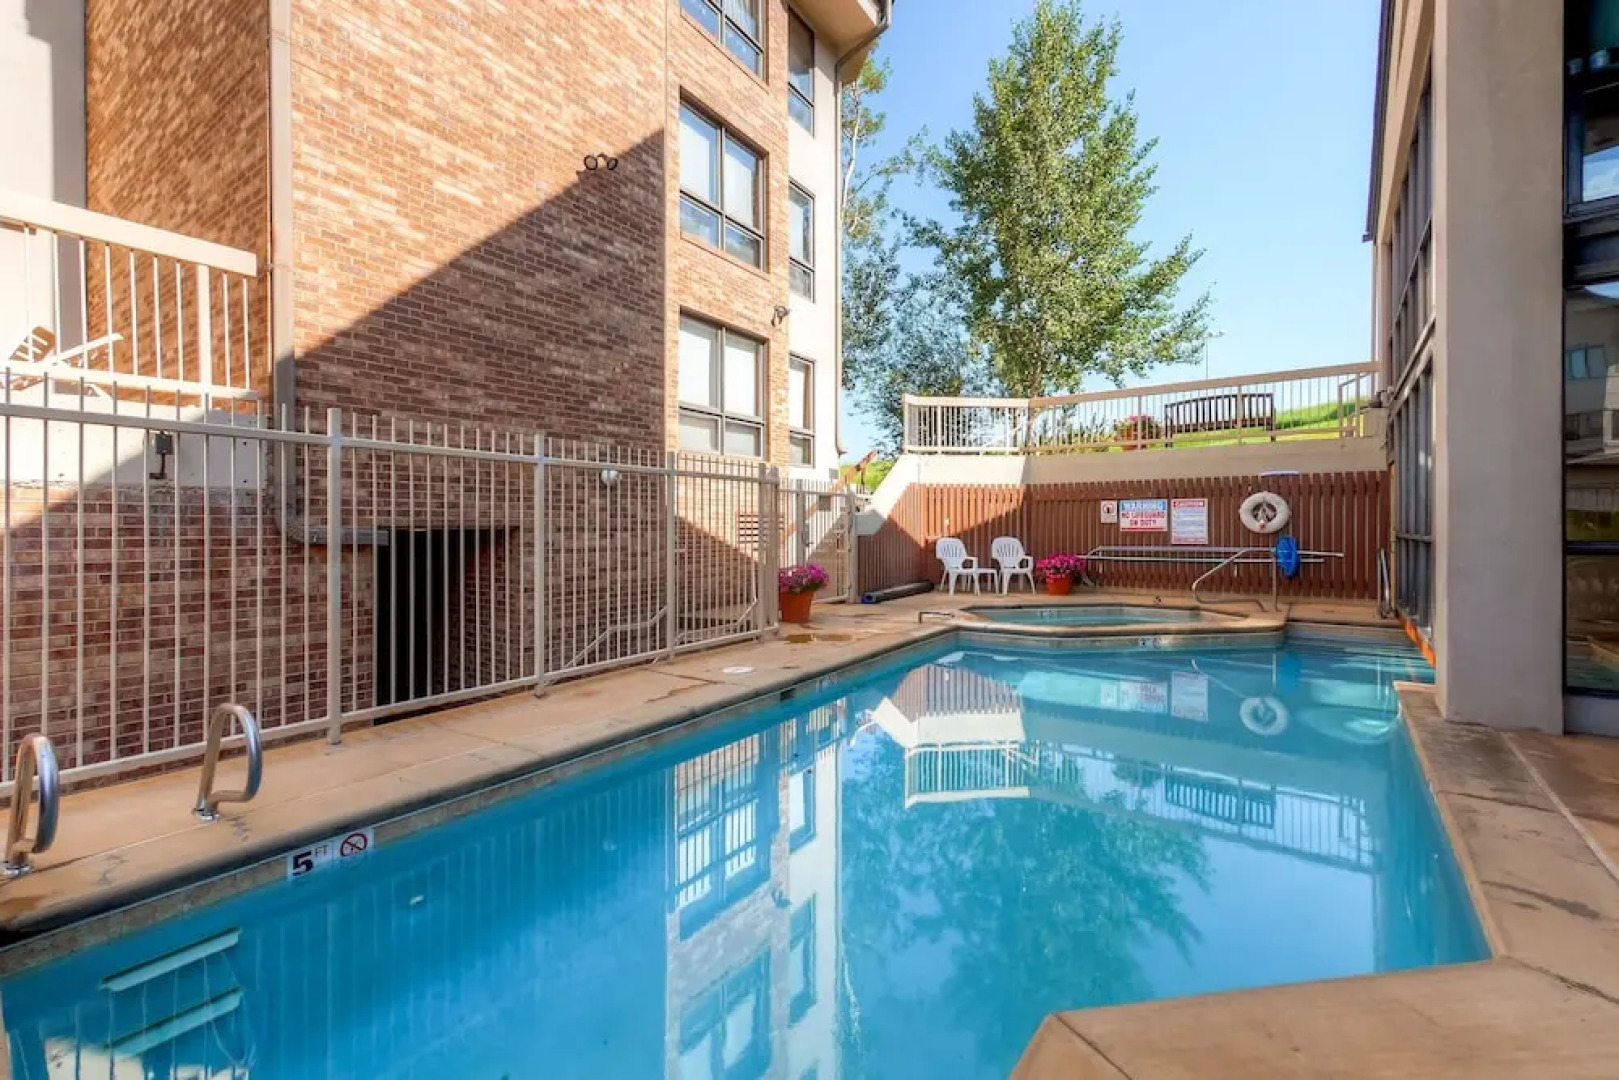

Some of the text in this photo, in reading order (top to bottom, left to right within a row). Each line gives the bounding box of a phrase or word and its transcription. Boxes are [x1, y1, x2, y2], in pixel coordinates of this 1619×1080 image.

[1122, 511, 1130, 519] NO
[292, 845, 328, 876] 5 FT
